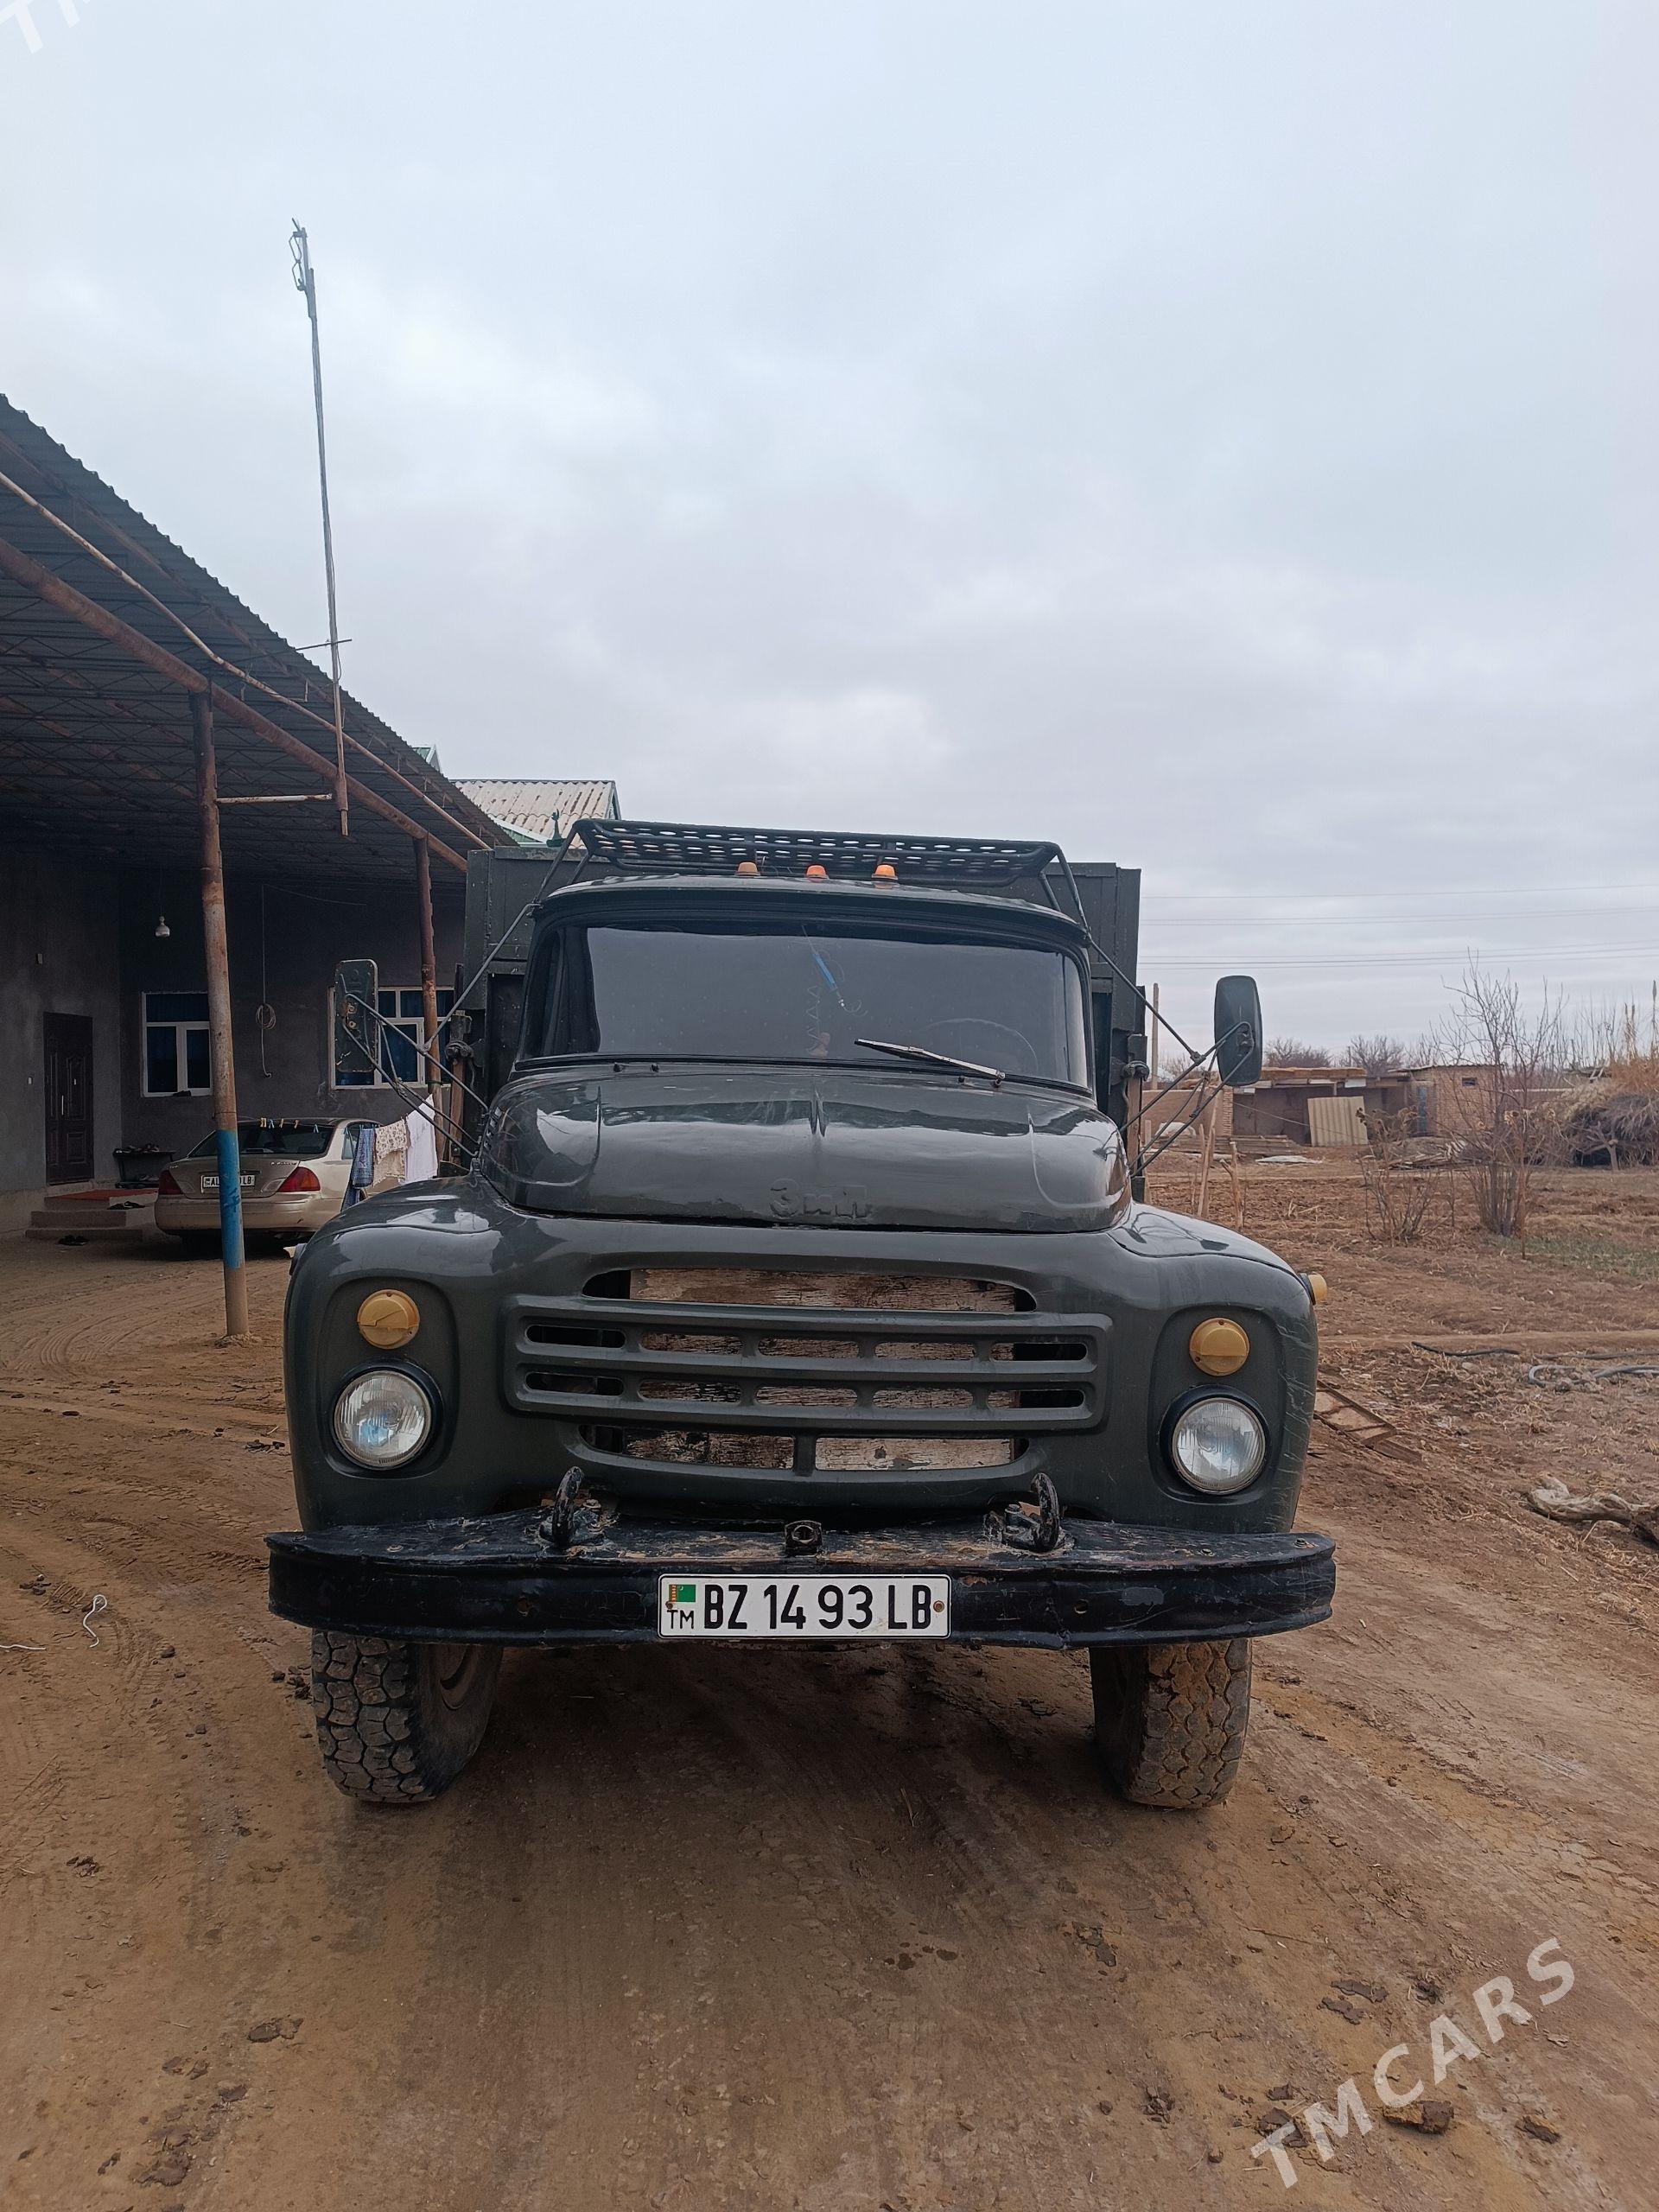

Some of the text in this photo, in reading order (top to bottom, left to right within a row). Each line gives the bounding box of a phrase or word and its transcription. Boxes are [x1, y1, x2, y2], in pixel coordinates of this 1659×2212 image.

[667, 1610, 694, 1629] TM
[704, 1585, 931, 1630] BZ 14 93 LB
